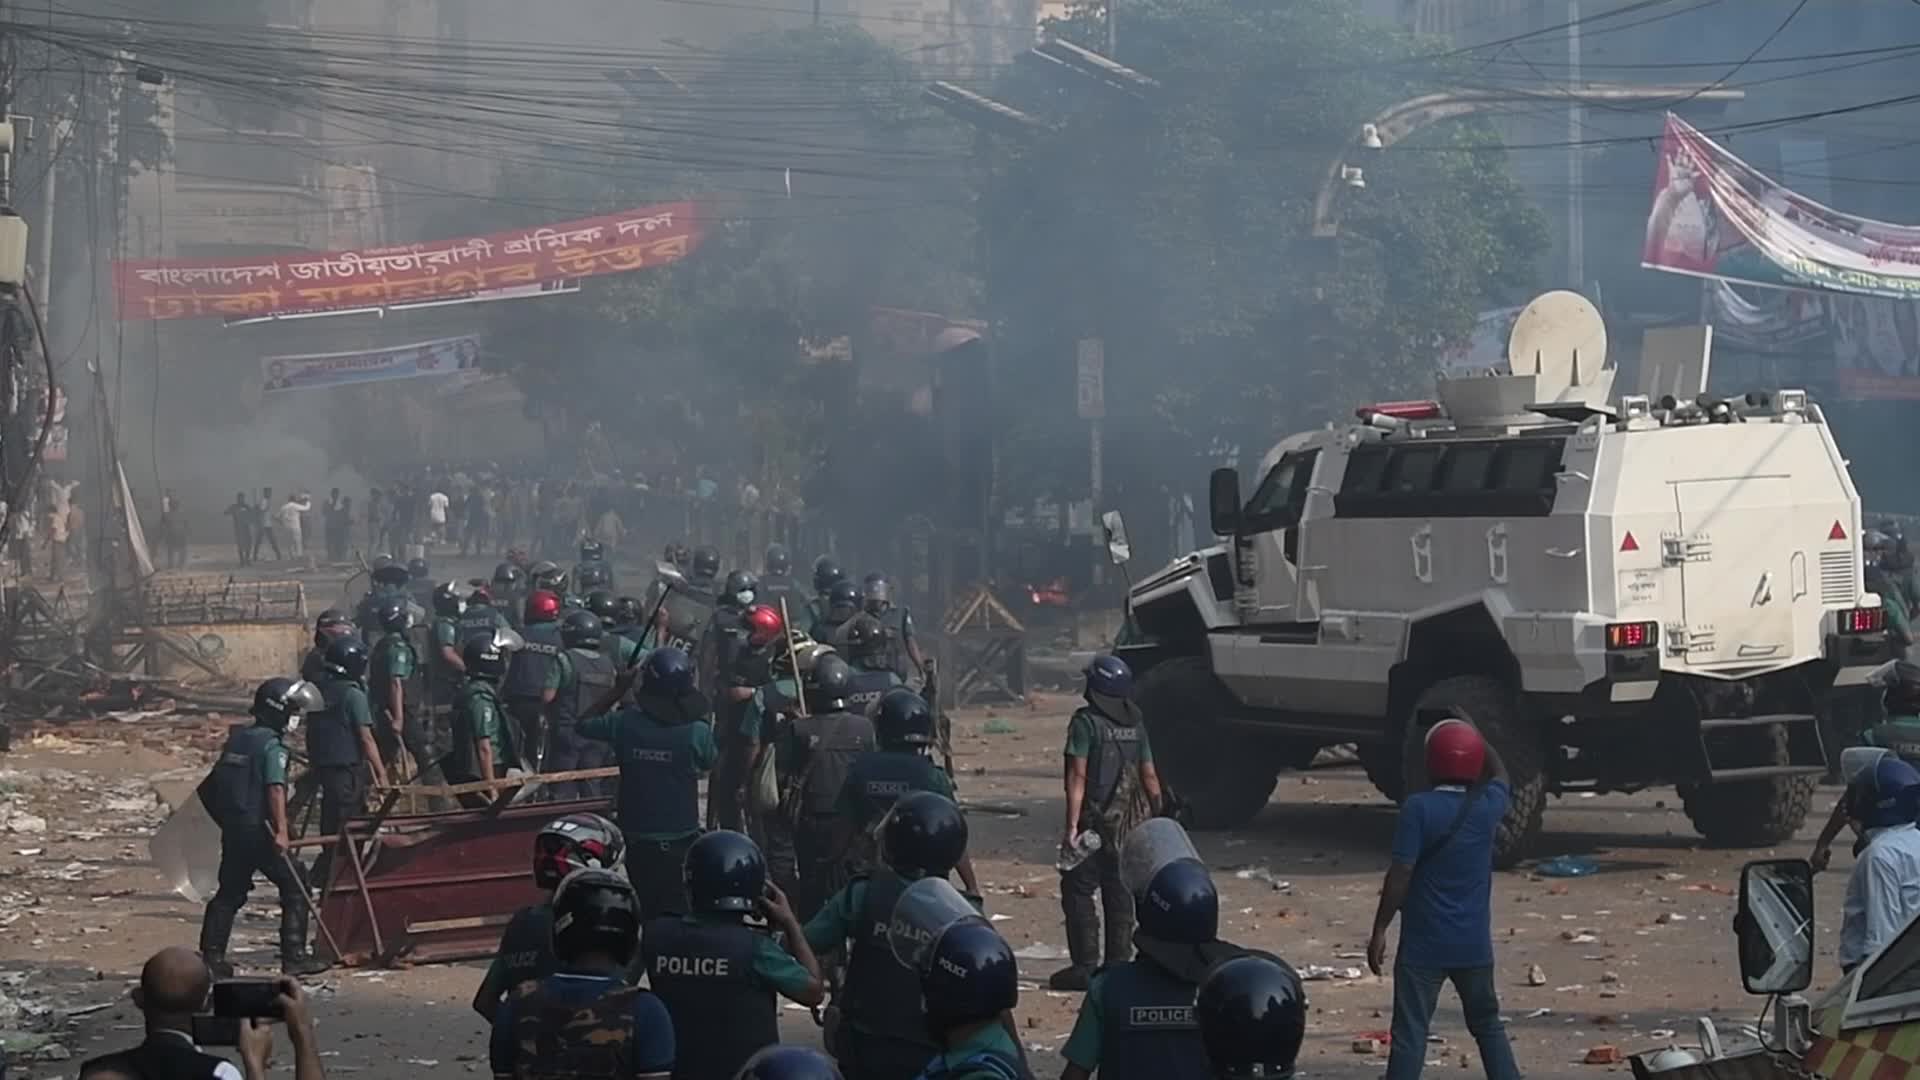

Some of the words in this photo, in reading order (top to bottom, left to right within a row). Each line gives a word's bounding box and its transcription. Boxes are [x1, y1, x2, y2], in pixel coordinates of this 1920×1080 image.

[136, 262, 282, 287] বাংলাদেশ
[288, 238, 495, 280] জাতীয়তাবাদী
[504, 227, 607, 256] শ্রমিক
[615, 212, 673, 238] দল
[552, 234, 689, 276] উত্তর
[524, 642, 558, 654] POLICE
[655, 955, 729, 976] POLICE
[938, 956, 969, 979] POLICE
[1136, 1009, 1193, 1021] POLICE
